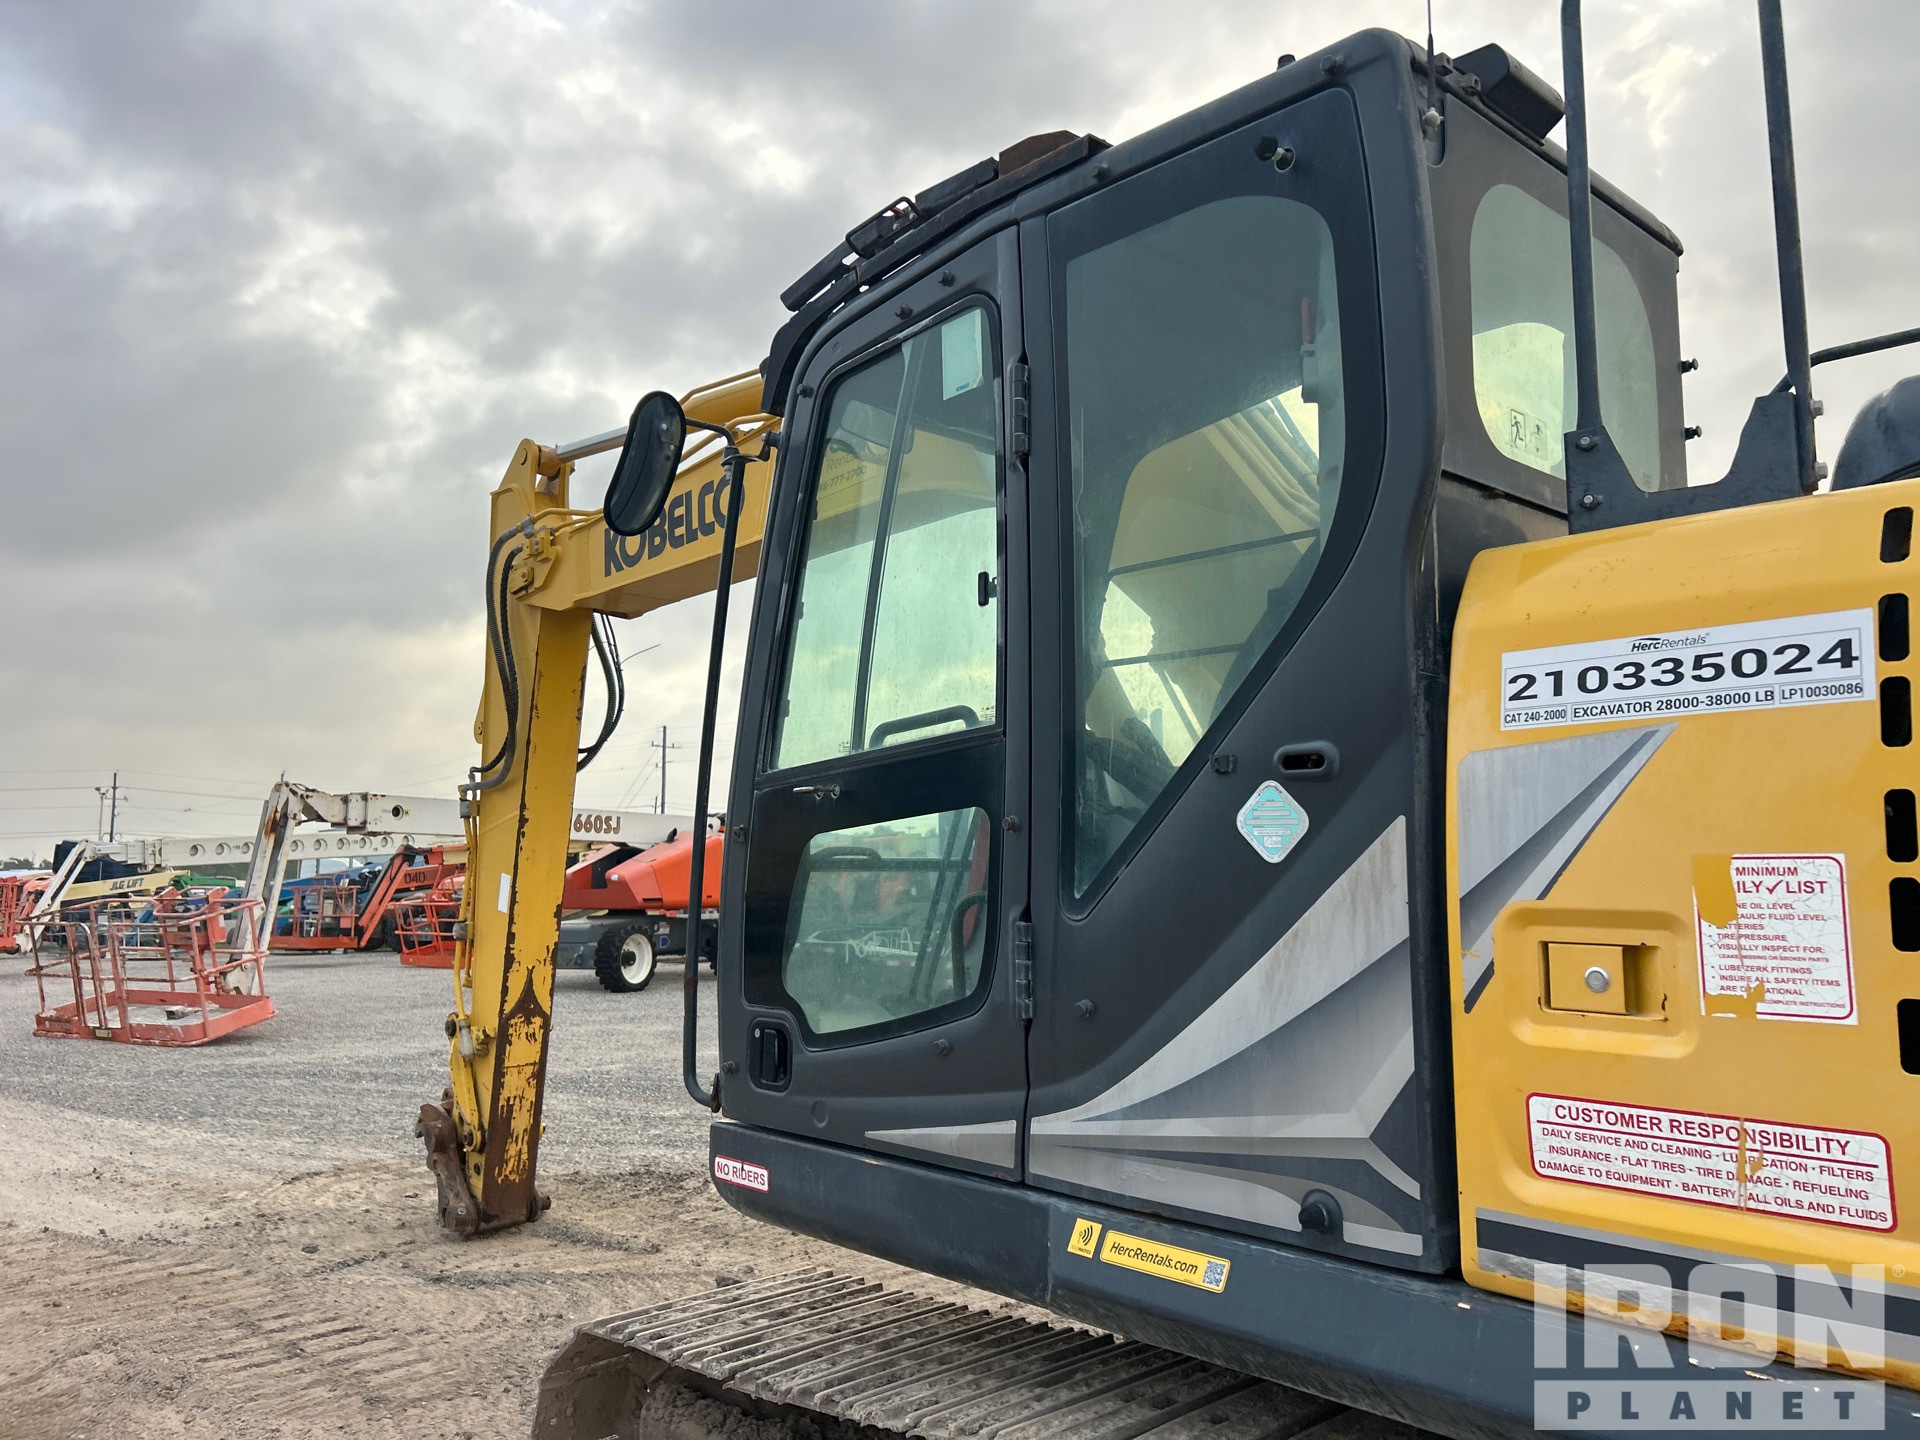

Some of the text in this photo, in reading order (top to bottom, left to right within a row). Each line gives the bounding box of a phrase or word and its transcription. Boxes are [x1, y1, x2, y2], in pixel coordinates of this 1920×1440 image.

[605, 474, 746, 578] KOBELCO
[1631, 633, 1707, 652] HercRentals
[1508, 638, 1859, 702] 210335024
[1781, 682, 1863, 700] LP10030086
[1573, 690, 1775, 719] EXCAVATOR 28000-38000 LB
[1504, 708, 1566, 724] CAT 240-2000
[573, 813, 621, 835] 660SJ
[1735, 866, 1799, 877] MINIMUM
[110, 877, 144, 891] JLG LIFT
[1736, 880, 1828, 894] ILY LIST
[1749, 902, 1765, 910] OIL
[1768, 913, 1795, 921] FLUID
[1717, 923, 1764, 931] TTERIES
[1739, 933, 1787, 942] PRESSURE
[1717, 943, 1826, 954] VISUALLY INSPECT FOR:
[1718, 964, 1812, 975] LUBE ZERK FITTINGS
[1719, 974, 1841, 987] INSURE ALL SAFETY ITEMS
[1740, 985, 1805, 996] OATIONAL
[1554, 1104, 1851, 1156] CUSTOMER RESPONSIBILITY
[1542, 1127, 1875, 1182] DAILY SERVICE AND CLEANING LURCATION FILTERS
[717, 1160, 766, 1186] NO RIDERS
[1548, 1144, 1870, 1201] INSURANCE FLAT TIRES TIRE DMAGE REFUELING
[1538, 1160, 1888, 1223] DAMAGE TO EQUIPMENT BATTERY ALL OILS AND FLUIDS
[1109, 1241, 1198, 1275] HercRentals.com
